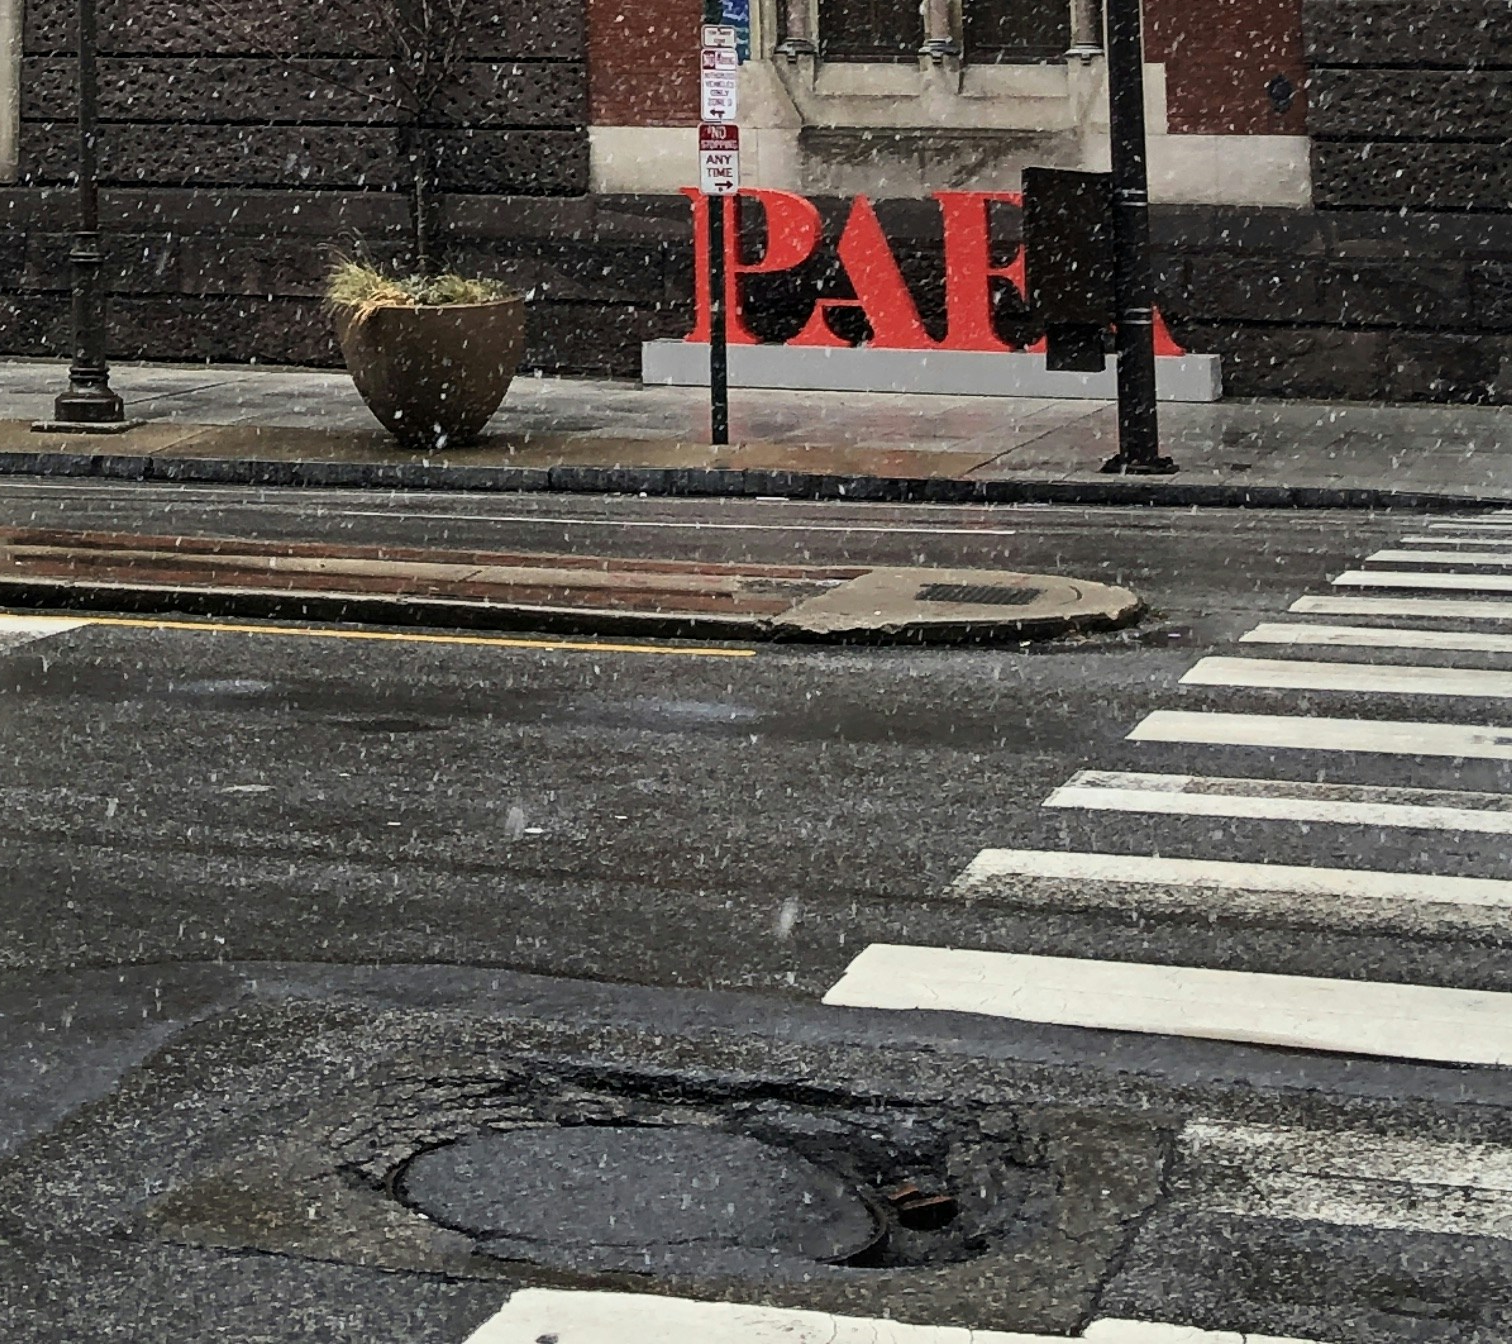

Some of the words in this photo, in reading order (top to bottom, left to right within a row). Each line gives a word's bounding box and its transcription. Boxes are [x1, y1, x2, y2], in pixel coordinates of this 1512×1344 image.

[710, 125, 727, 140] NO
[706, 154, 732, 165] ANY
[706, 167, 734, 178] TIME
[679, 187, 1186, 357] PAF
